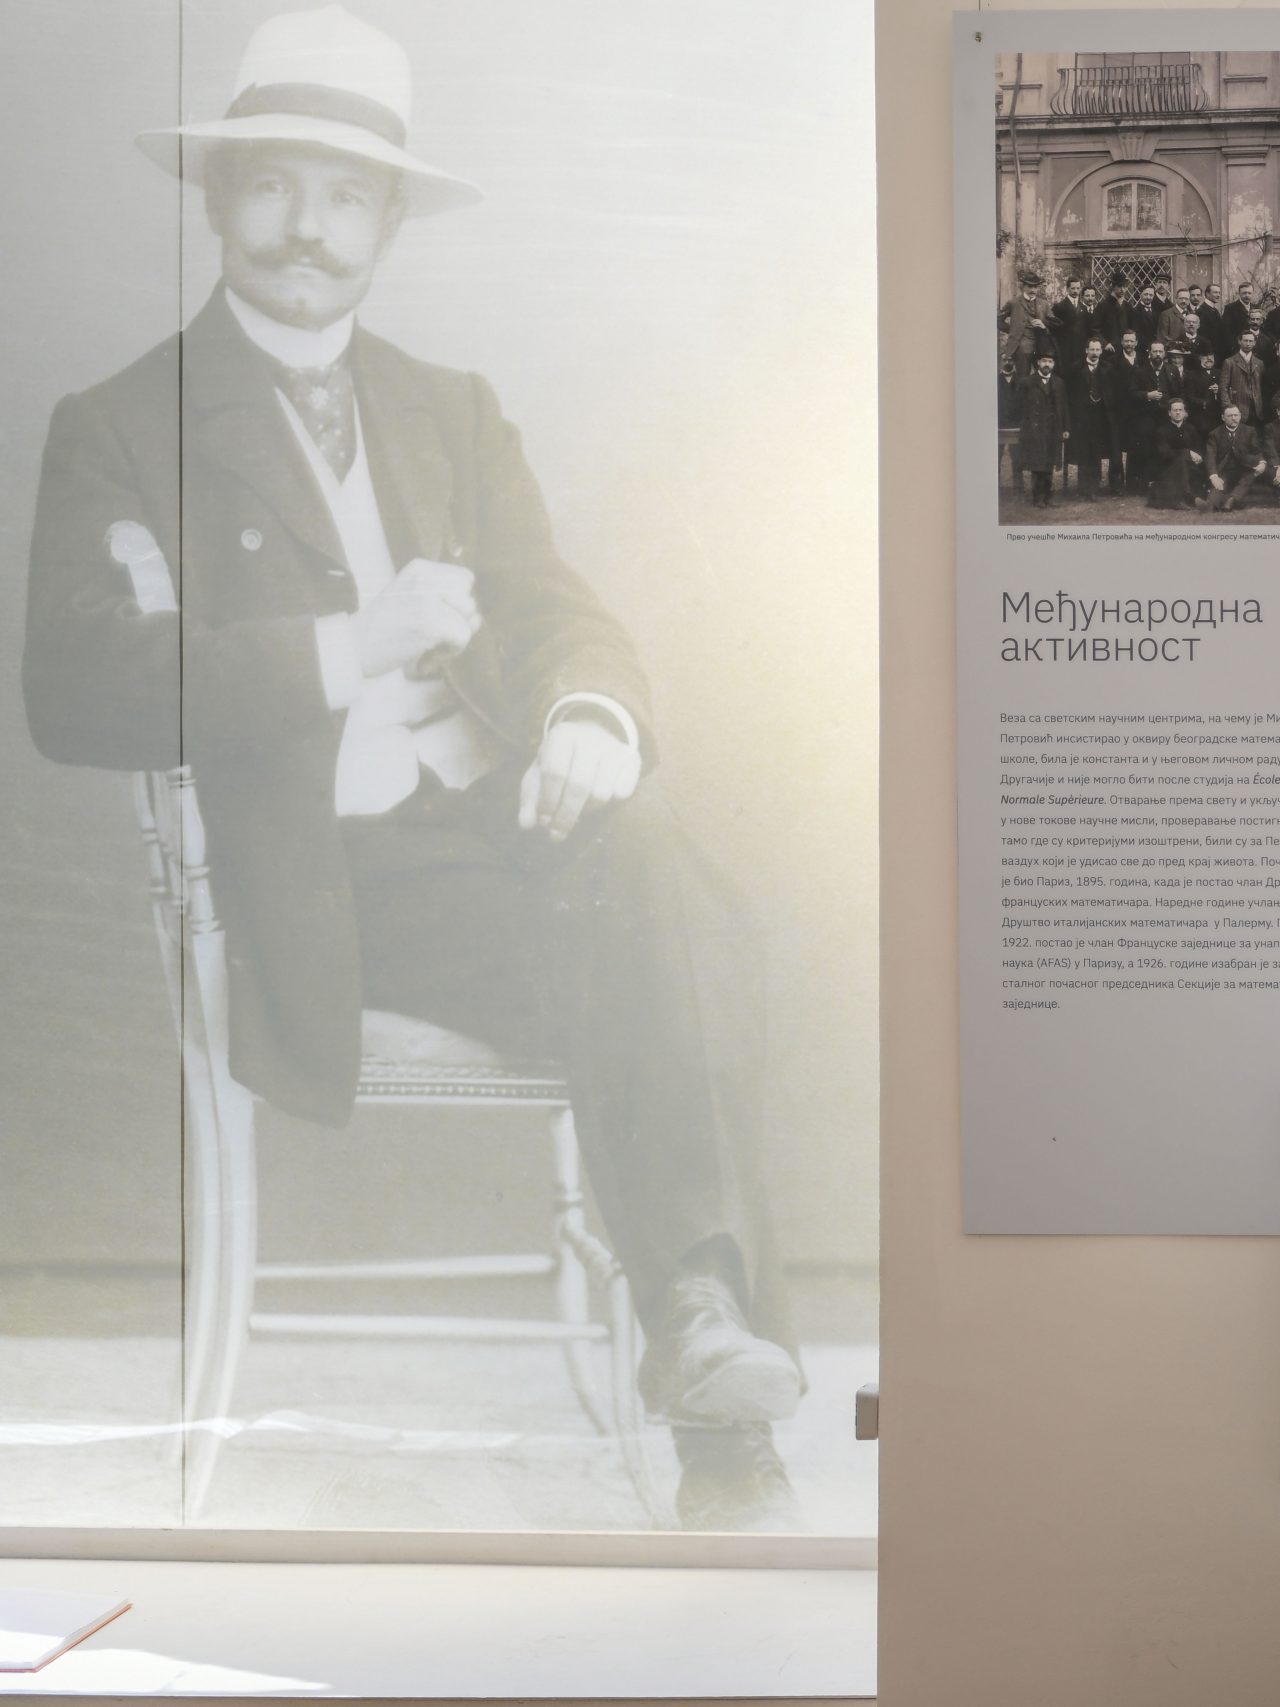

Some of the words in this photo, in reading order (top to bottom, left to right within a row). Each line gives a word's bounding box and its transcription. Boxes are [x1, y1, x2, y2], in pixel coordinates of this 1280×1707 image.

[1001, 590, 1263, 631] Међународна
[1001, 637, 1201, 662] активност
[1000, 712, 1026, 723] Веза
[1029, 715, 1041, 723] са
[1043, 715, 1095, 723] светским
[1099, 715, 1145, 726] научним
[1149, 715, 1205, 726] центрима,
[1209, 715, 1222, 724] на
[1224, 715, 1251, 726] чему
[1254, 712, 1263, 726] је
[1001, 733, 1053, 745] Петровић
[1057, 735, 1120, 746] инсистирао
[1124, 735, 1129, 746] у
[1133, 735, 1170, 746] оквиру
[1174, 733, 1238, 746] београдске
[1001, 837, 1027, 846] тамо
[1031, 837, 1048, 847] где
[1052, 837, 1063, 848] су
[1067, 835, 1135, 848] критеријуми
[1139, 837, 1202, 848] изоштрени,
[1206, 835, 1232, 846] били
[1236, 837, 1247, 849] су
[1250, 838, 1262, 846] за
[1003, 980, 1046, 989] сталног
[1050, 980, 1099, 989] почасног
[1103, 980, 1174, 991] председника
[1178, 978, 1220, 991] Секције
[1224, 981, 1236, 989] за
